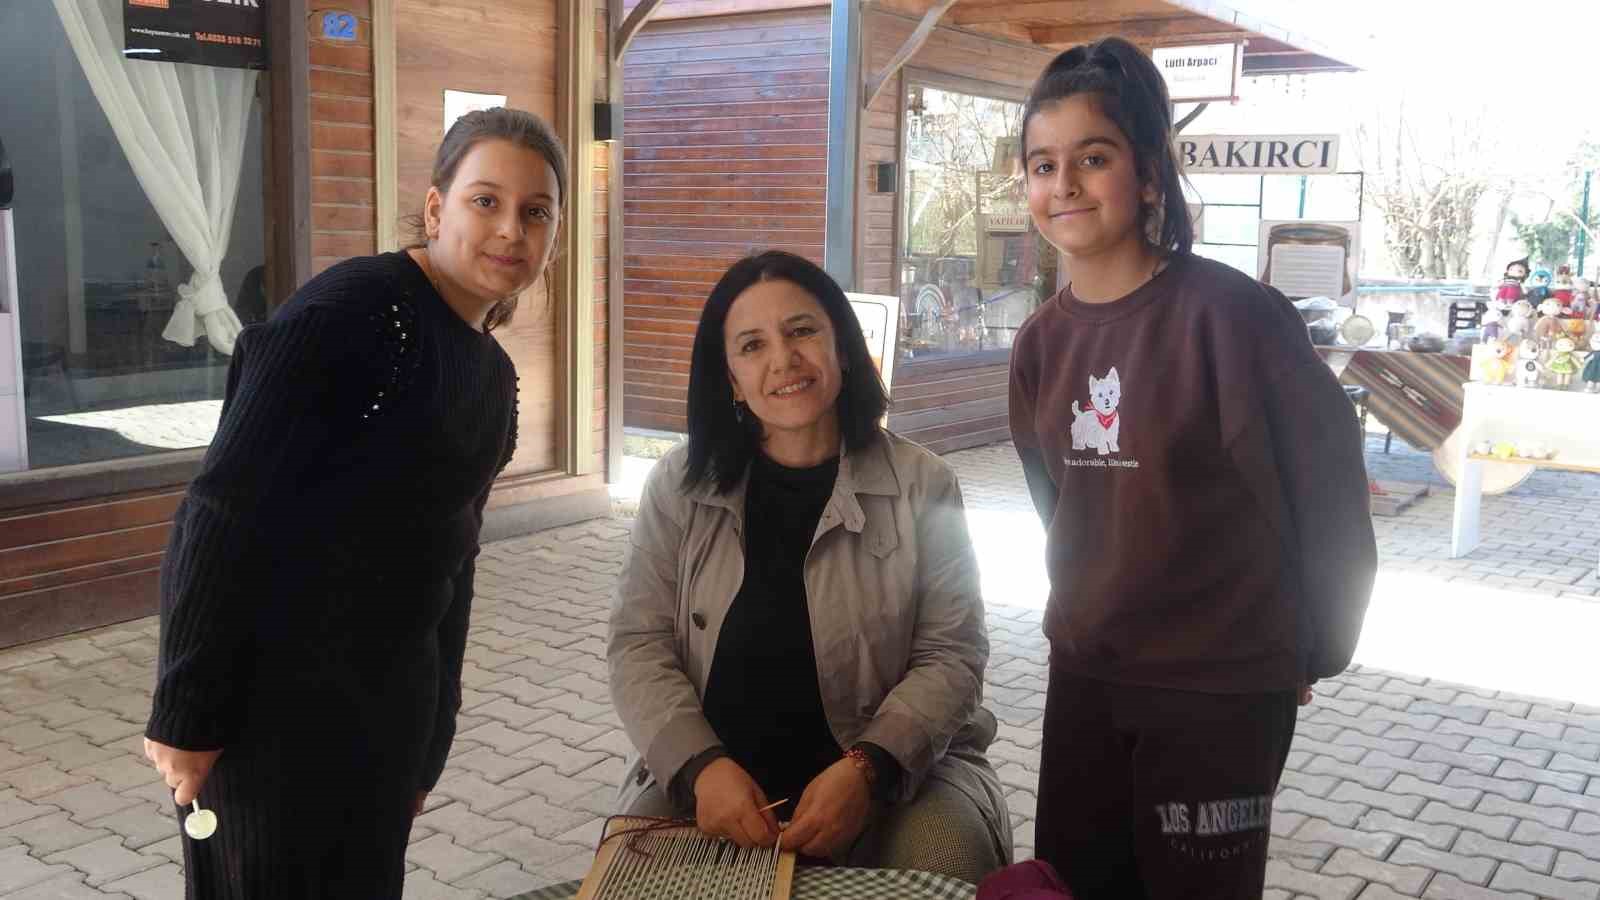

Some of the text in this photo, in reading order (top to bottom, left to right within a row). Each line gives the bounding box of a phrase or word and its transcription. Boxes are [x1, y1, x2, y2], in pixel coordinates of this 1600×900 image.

[322, 12, 358, 40] 82
[1180, 140, 1331, 168] BAKIRCI
[1155, 802, 1190, 833] LOS
